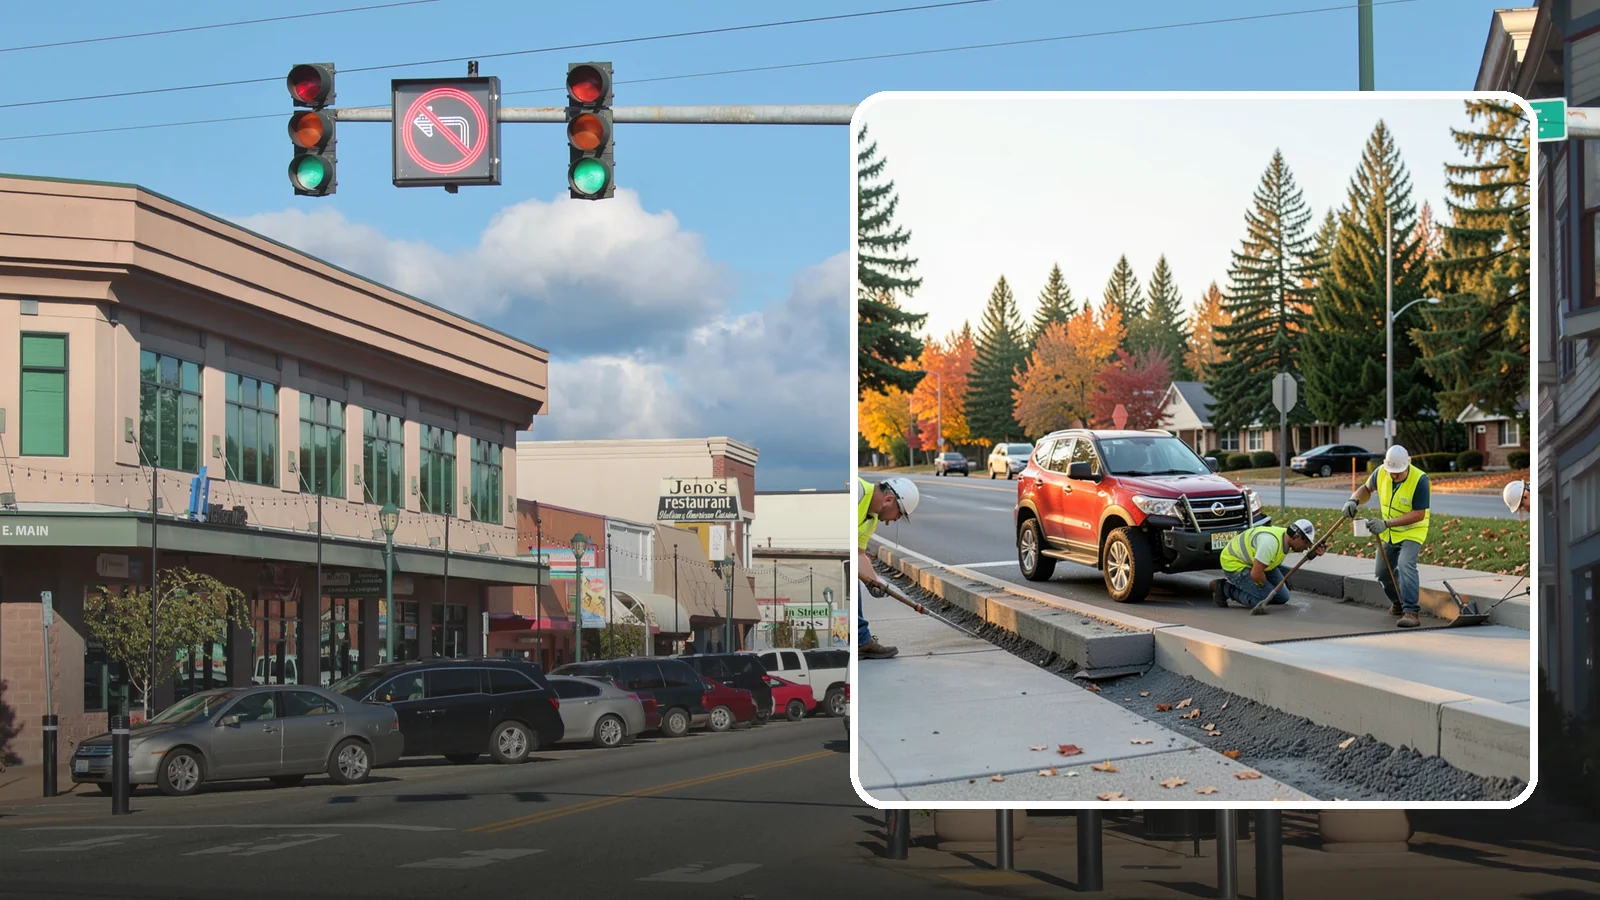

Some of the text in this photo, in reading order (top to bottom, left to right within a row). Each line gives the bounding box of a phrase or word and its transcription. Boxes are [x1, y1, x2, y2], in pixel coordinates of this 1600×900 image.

[670, 480, 728, 494] Jeno's
[665, 496, 730, 508] restaurant
[658, 510, 680, 520] Italian
[686, 510, 714, 519] American
[715, 510, 737, 519] Cuisine
[2, 525, 49, 536] E. MAIN
[798, 608, 828, 616] Street
